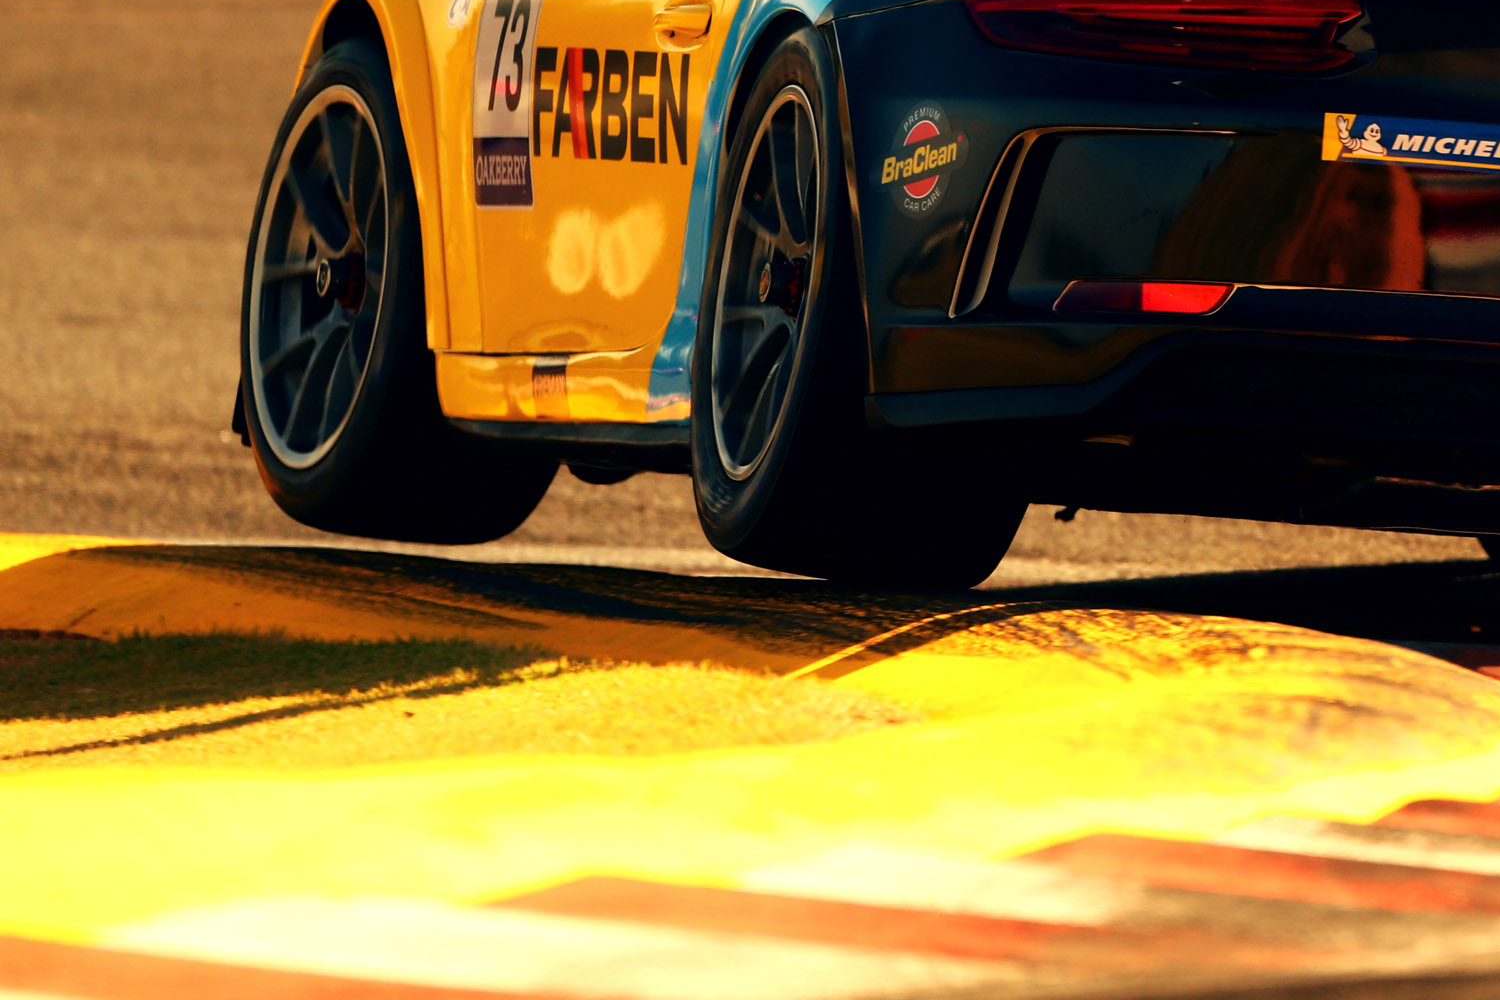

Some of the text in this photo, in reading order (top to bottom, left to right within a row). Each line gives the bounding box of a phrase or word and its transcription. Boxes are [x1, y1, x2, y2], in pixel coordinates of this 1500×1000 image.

[533, 47, 690, 165] FARBEN
[903, 107, 941, 132] PREMIUM
[476, 156, 527, 185] OAKBERRY
[881, 142, 957, 184] BraClean
[904, 187, 942, 212] CAR CARE
